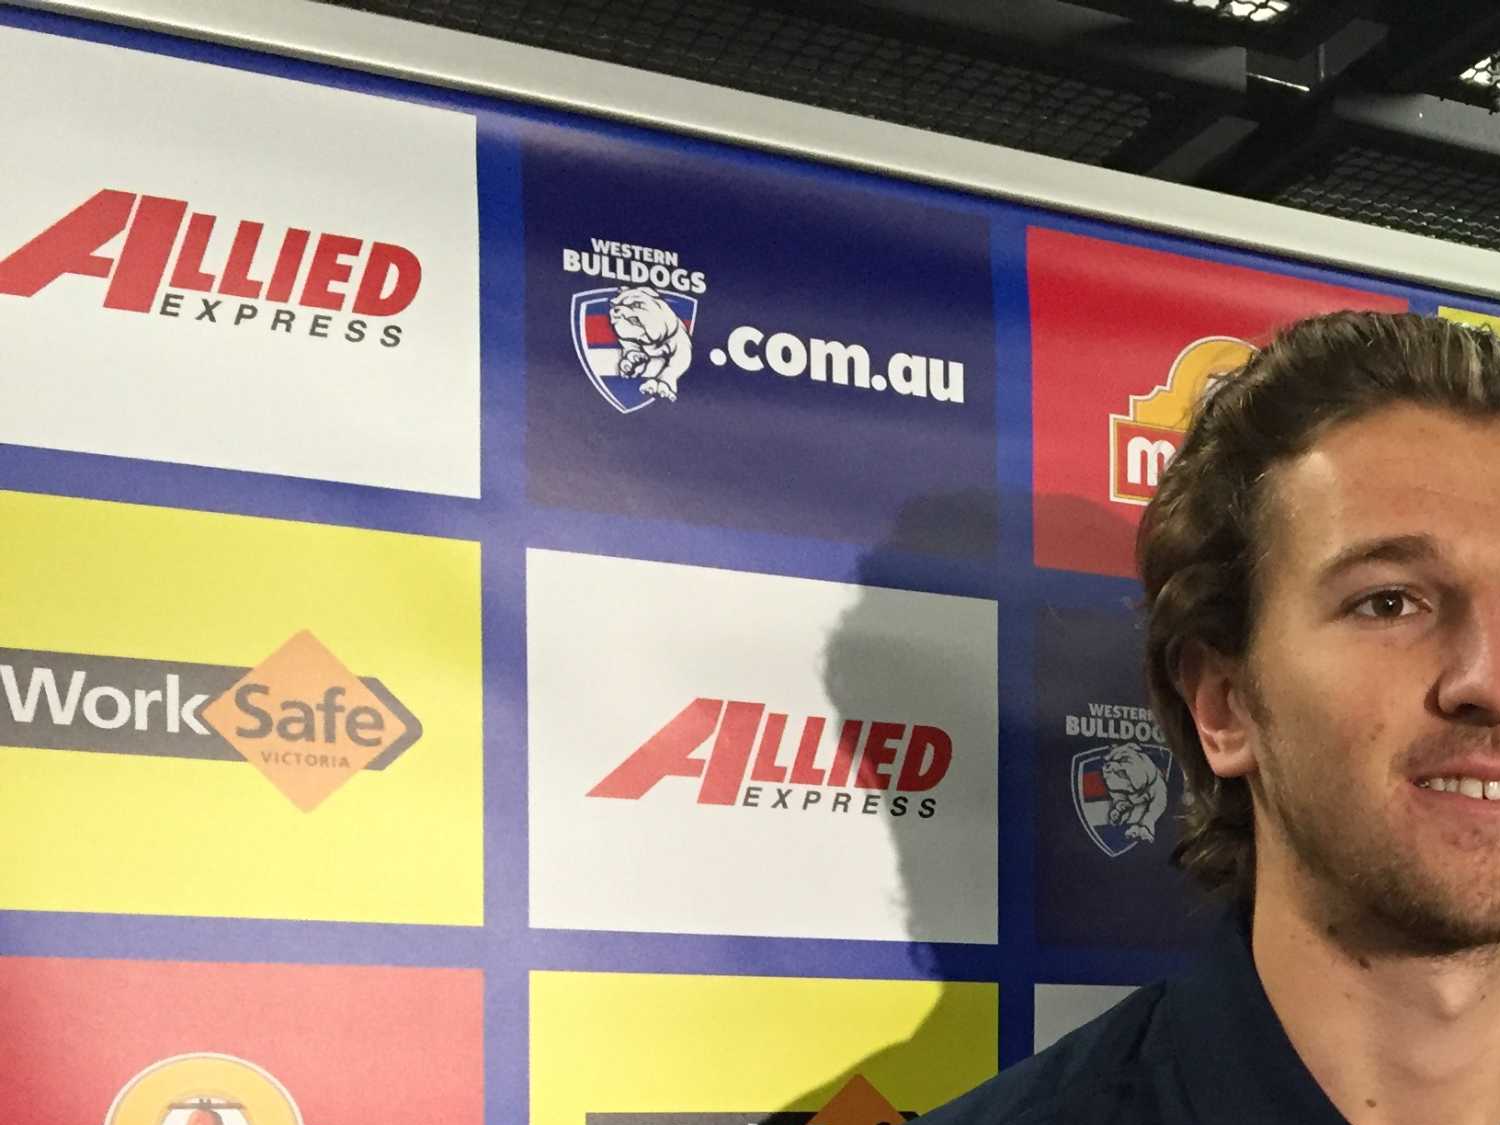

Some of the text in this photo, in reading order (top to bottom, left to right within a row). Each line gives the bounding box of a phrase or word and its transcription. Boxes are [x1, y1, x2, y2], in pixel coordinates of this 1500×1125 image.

[0, 189, 422, 316] ALLIED
[563, 249, 706, 293] BULLDOGS
[591, 237, 678, 266] WESTERN
[160, 294, 403, 348] EXPRESS
[709, 326, 965, 404] .com.au
[260, 750, 351, 769] VICTORIA
[585, 697, 953, 807] ALLIED
[743, 787, 937, 819] EXPRESS
